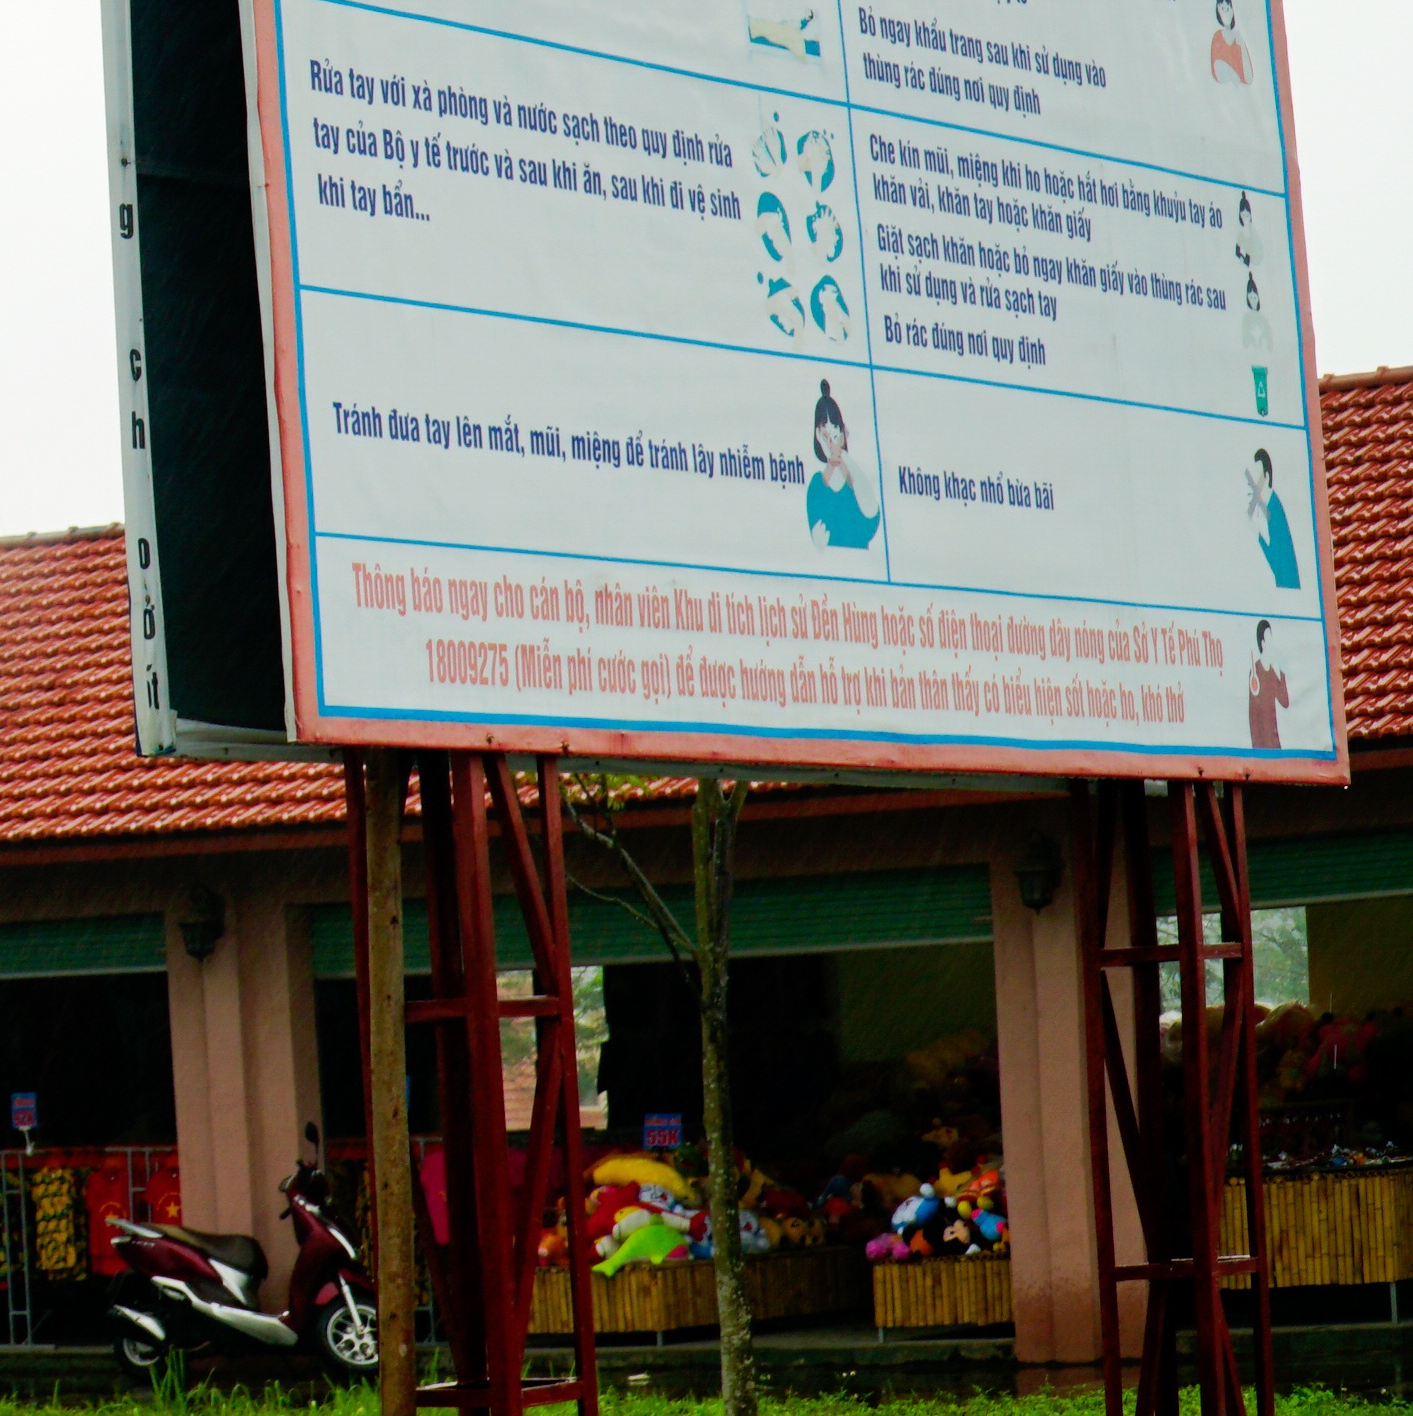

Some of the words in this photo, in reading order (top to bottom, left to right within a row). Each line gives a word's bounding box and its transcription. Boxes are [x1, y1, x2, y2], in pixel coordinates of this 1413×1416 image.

[861, 51, 901, 89] thùng
[902, 60, 926, 91] rác
[927, 65, 961, 102] đúng
[962, 76, 985, 104] nơi
[987, 82, 1010, 112] quy
[1012, 83, 1041, 118] định
[316, 172, 346, 208] khi
[349, 178, 376, 218] tay
[878, 262, 902, 294] khi
[904, 264, 922, 296] sử
[923, 269, 958, 306] dụng
[959, 275, 977, 306] và
[978, 276, 1001, 310] rửa
[1003, 286, 1035, 318] sạch
[1036, 289, 1057, 322] tay
[882, 311, 902, 345] Bỏ
[904, 317, 928, 348] rác
[930, 321, 965, 357] đúng
[966, 329, 988, 357] nơi
[990, 335, 1014, 365] quy
[1017, 334, 1046, 370] định
[331, 400, 383, 439] Tránh
[387, 407, 420, 443] đưa
[423, 412, 451, 450] tay
[454, 414, 483, 449] lên
[486, 413, 525, 457] mắt,
[528, 424, 566, 462] mũi,
[570, 430, 621, 469] miệng
[624, 429, 644, 467] để
[647, 438, 689, 472] tránh
[690, 442, 714, 479] lây
[717, 443, 766, 481] nhiễm
[767, 451, 805, 489] bệnh
[897, 464, 941, 501] Không
[942, 469, 977, 507] khạc
[978, 470, 1004, 505] nhổ
[1005, 477, 1032, 508] bừa
[1032, 480, 1054, 511] bãi
